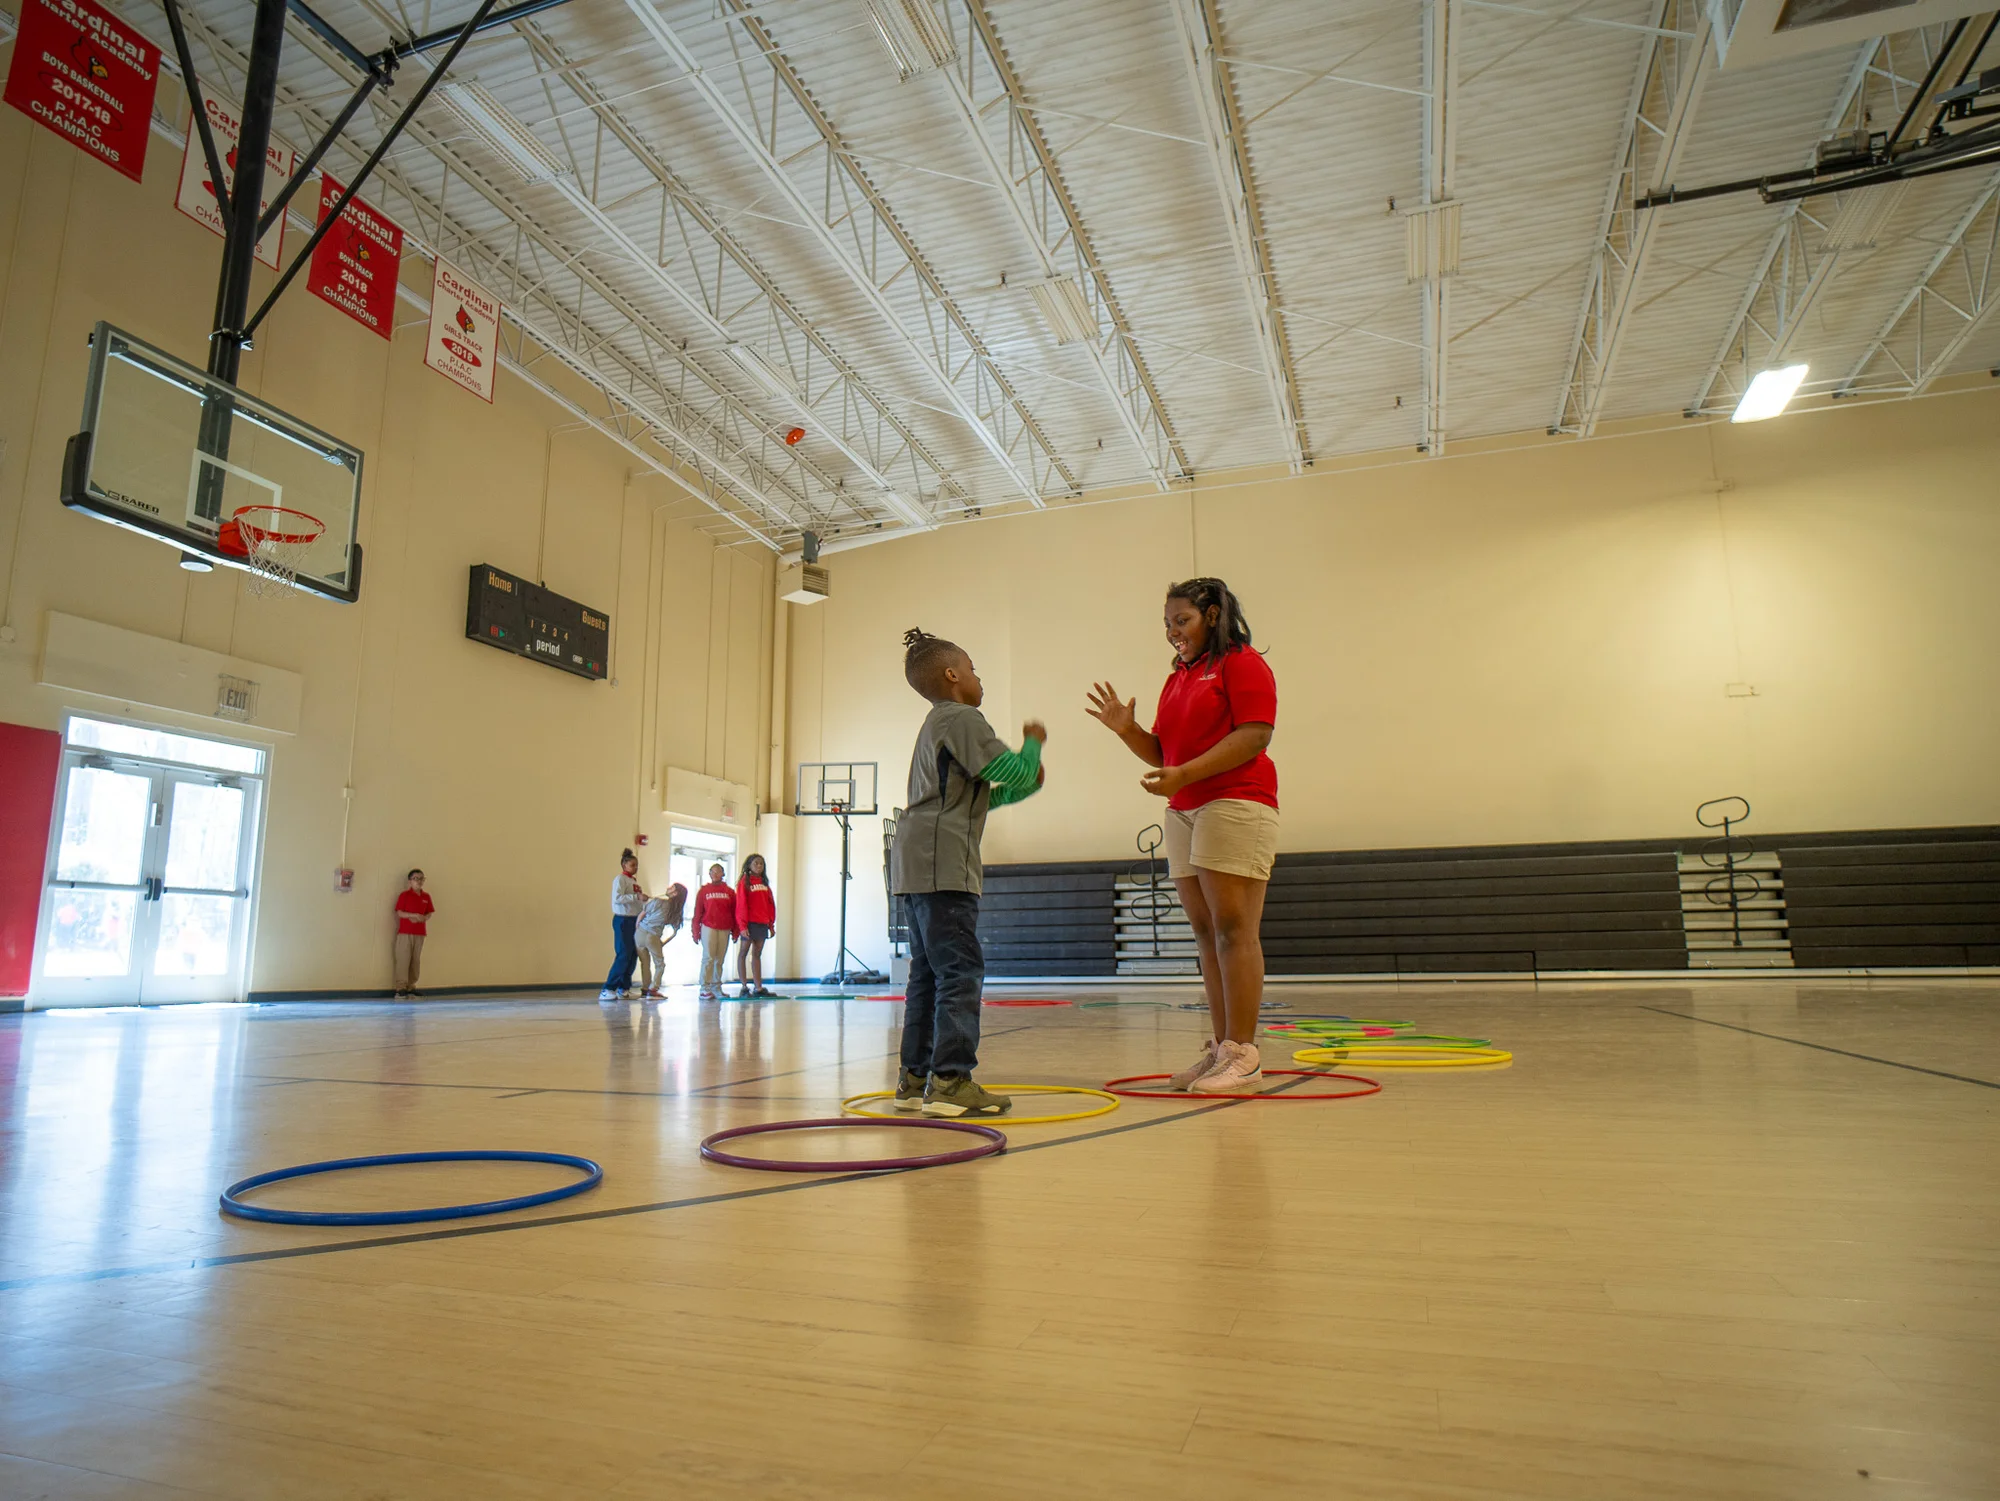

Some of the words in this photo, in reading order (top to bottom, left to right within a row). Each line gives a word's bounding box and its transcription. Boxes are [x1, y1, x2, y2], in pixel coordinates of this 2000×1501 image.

[40, 0, 87, 32] harter
[90, 32, 152, 80] Academy
[61, 0, 146, 63] ardinal
[42, 51, 69, 76] BOYS
[70, 69, 124, 114] BASKETBALL
[52, 78, 111, 125] 2017-18
[31, 100, 120, 162] CHAMPIONS
[206, 99, 282, 163] Caral
[322, 197, 357, 226] Chrter
[359, 224, 398, 256] Academy
[338, 251, 355, 269] BOYS
[355, 262, 374, 281] TRACK
[341, 269, 368, 294] 2018
[323, 285, 378, 326] CHAMPIONS
[437, 280, 463, 302] Charter
[465, 300, 496, 325] Academy
[442, 271, 493, 314] Cardinal
[444, 323, 462, 341] GIRLS
[463, 335, 483, 353] TRACK
[451, 342, 474, 363] 2018
[437, 358, 482, 391] CHAMPIONS
[121, 495, 159, 514] GARED
[488, 571, 512, 593] Home
[581, 610, 607, 631] Guests
[536, 639, 561, 656] period
[226, 687, 248, 709] EXIT
